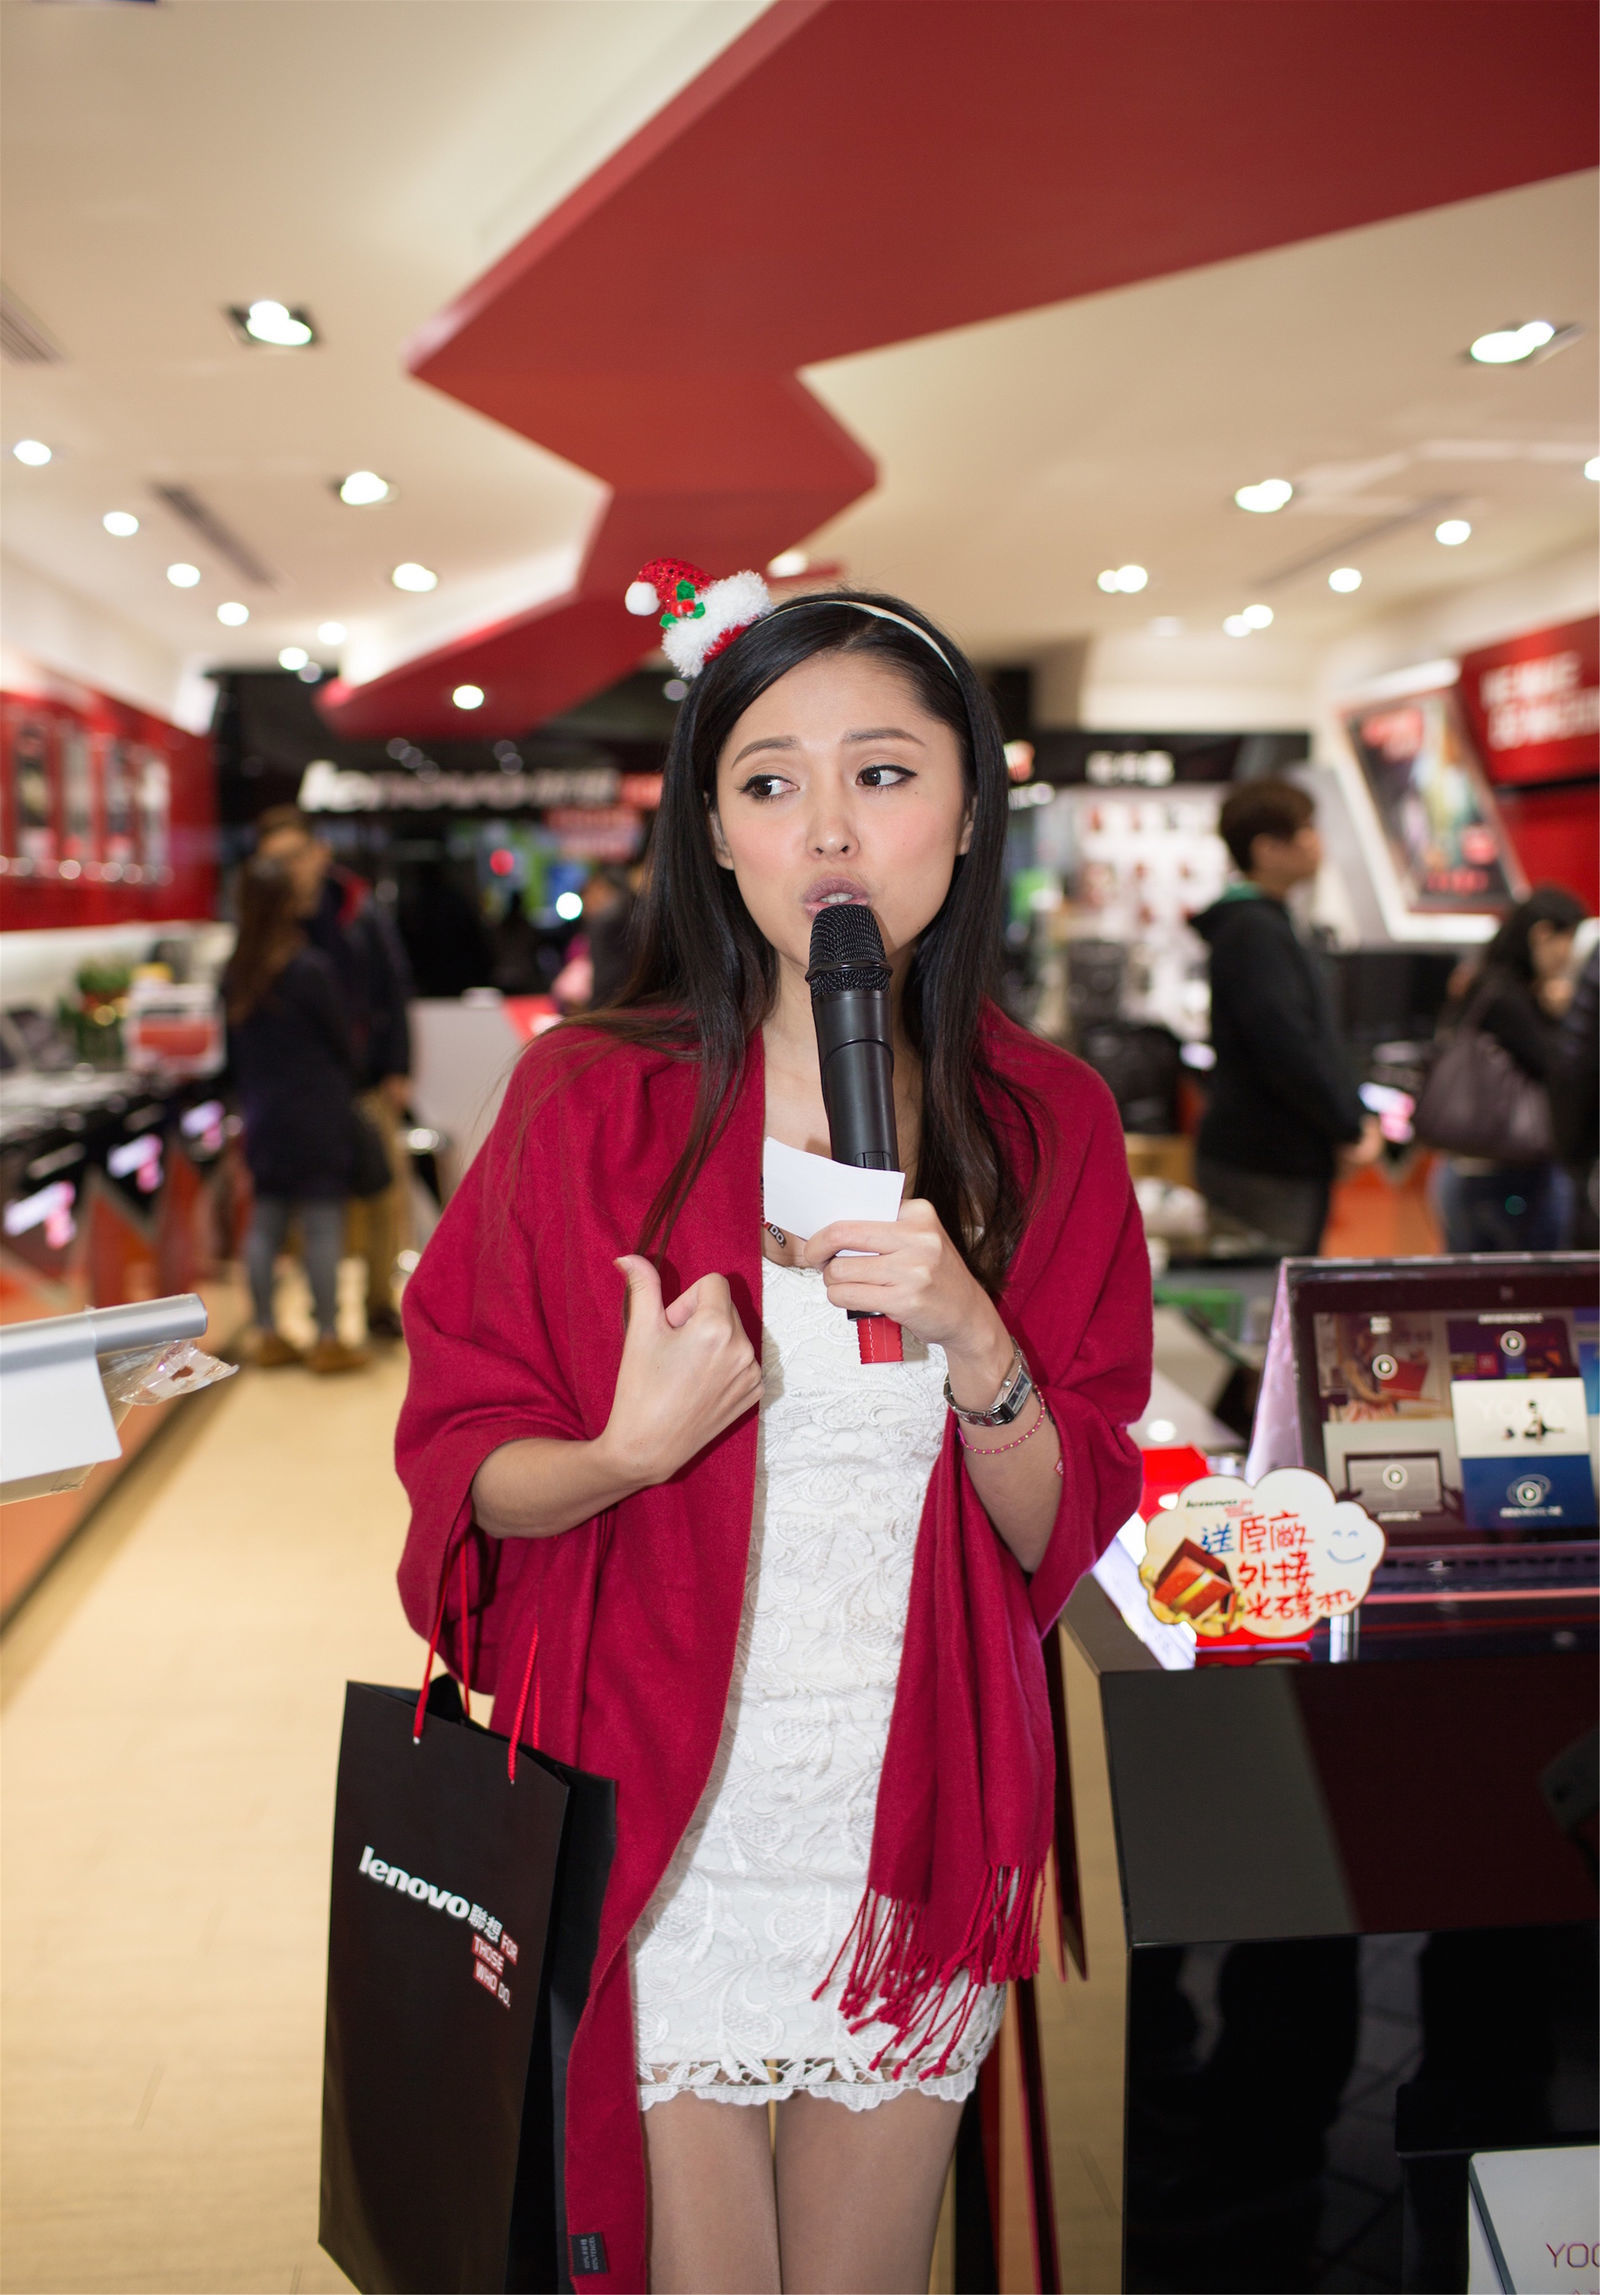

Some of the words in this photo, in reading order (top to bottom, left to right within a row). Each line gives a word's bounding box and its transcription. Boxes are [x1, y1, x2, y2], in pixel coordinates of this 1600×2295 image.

[358, 1844, 470, 1919] lenovo
[474, 1934, 504, 1972] THOSE
[501, 1932, 518, 1962] FOR
[475, 1960, 498, 1992] WHO
